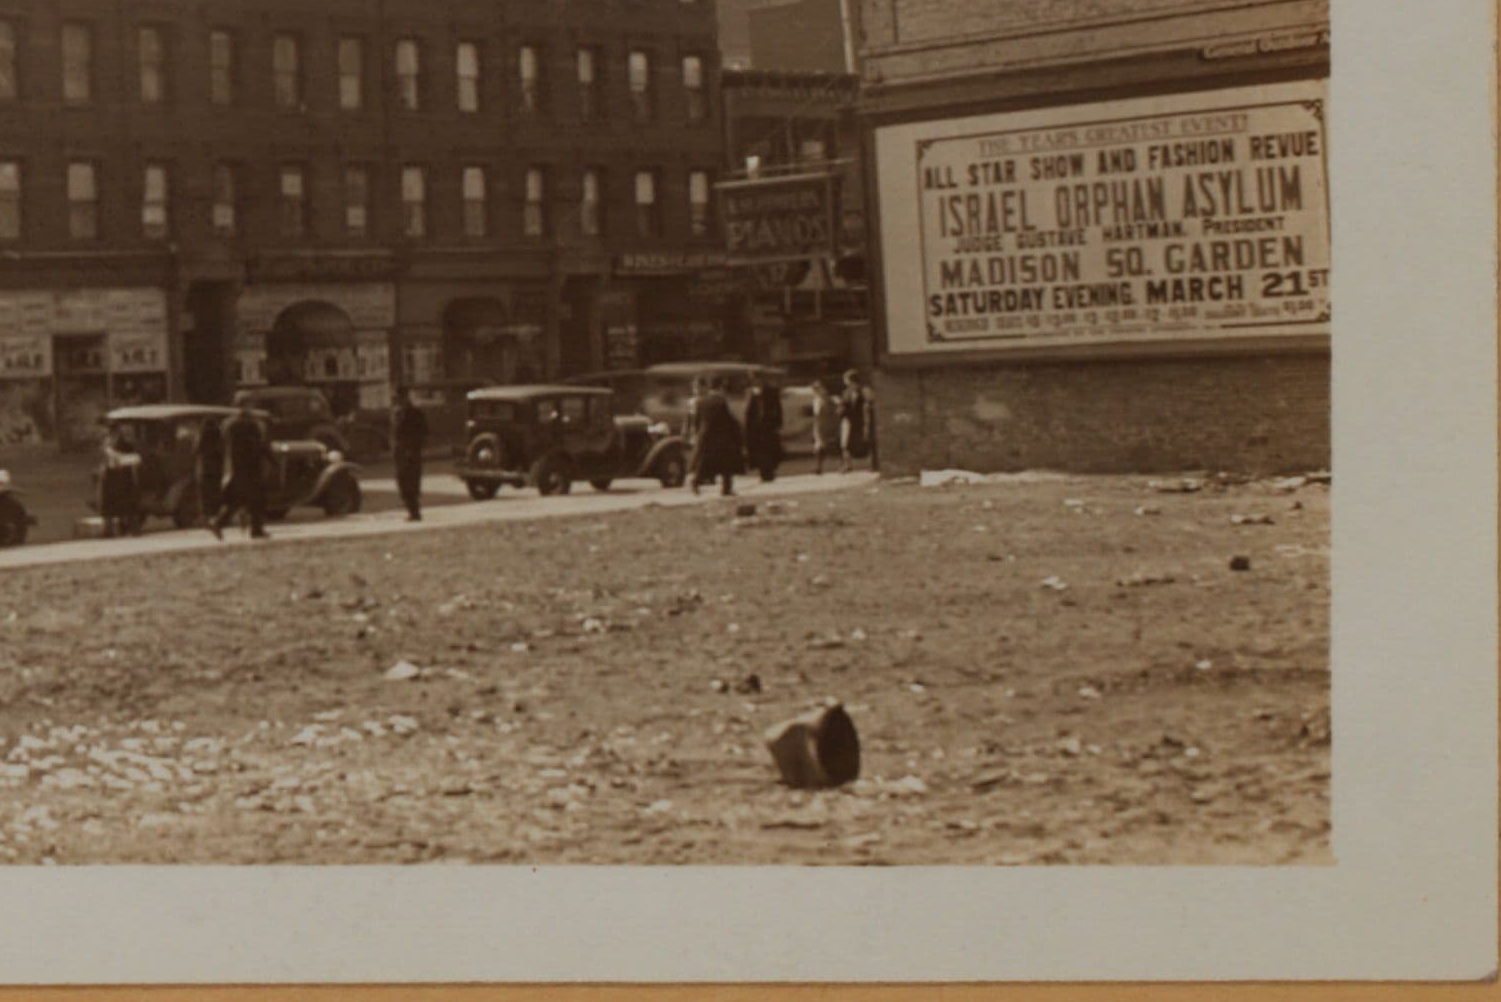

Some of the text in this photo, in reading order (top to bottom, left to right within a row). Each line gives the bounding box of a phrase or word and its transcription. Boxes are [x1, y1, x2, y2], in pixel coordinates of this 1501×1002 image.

[1085, 121, 1170, 142] GREATEST
[925, 131, 1320, 189] ALL STAR SHOW AND FASHION REVUE
[940, 165, 1303, 237] ISRAEL ORPHAN ASYLUM
[940, 235, 1304, 290] MADISON SQ. GARDEN
[953, 235, 1003, 254] JUDGE
[1016, 228, 1088, 250] GUSTAVE
[930, 287, 1046, 317] SATURDAY
[1053, 281, 1133, 310] EVENING
[1146, 274, 1244, 304] MARCH
